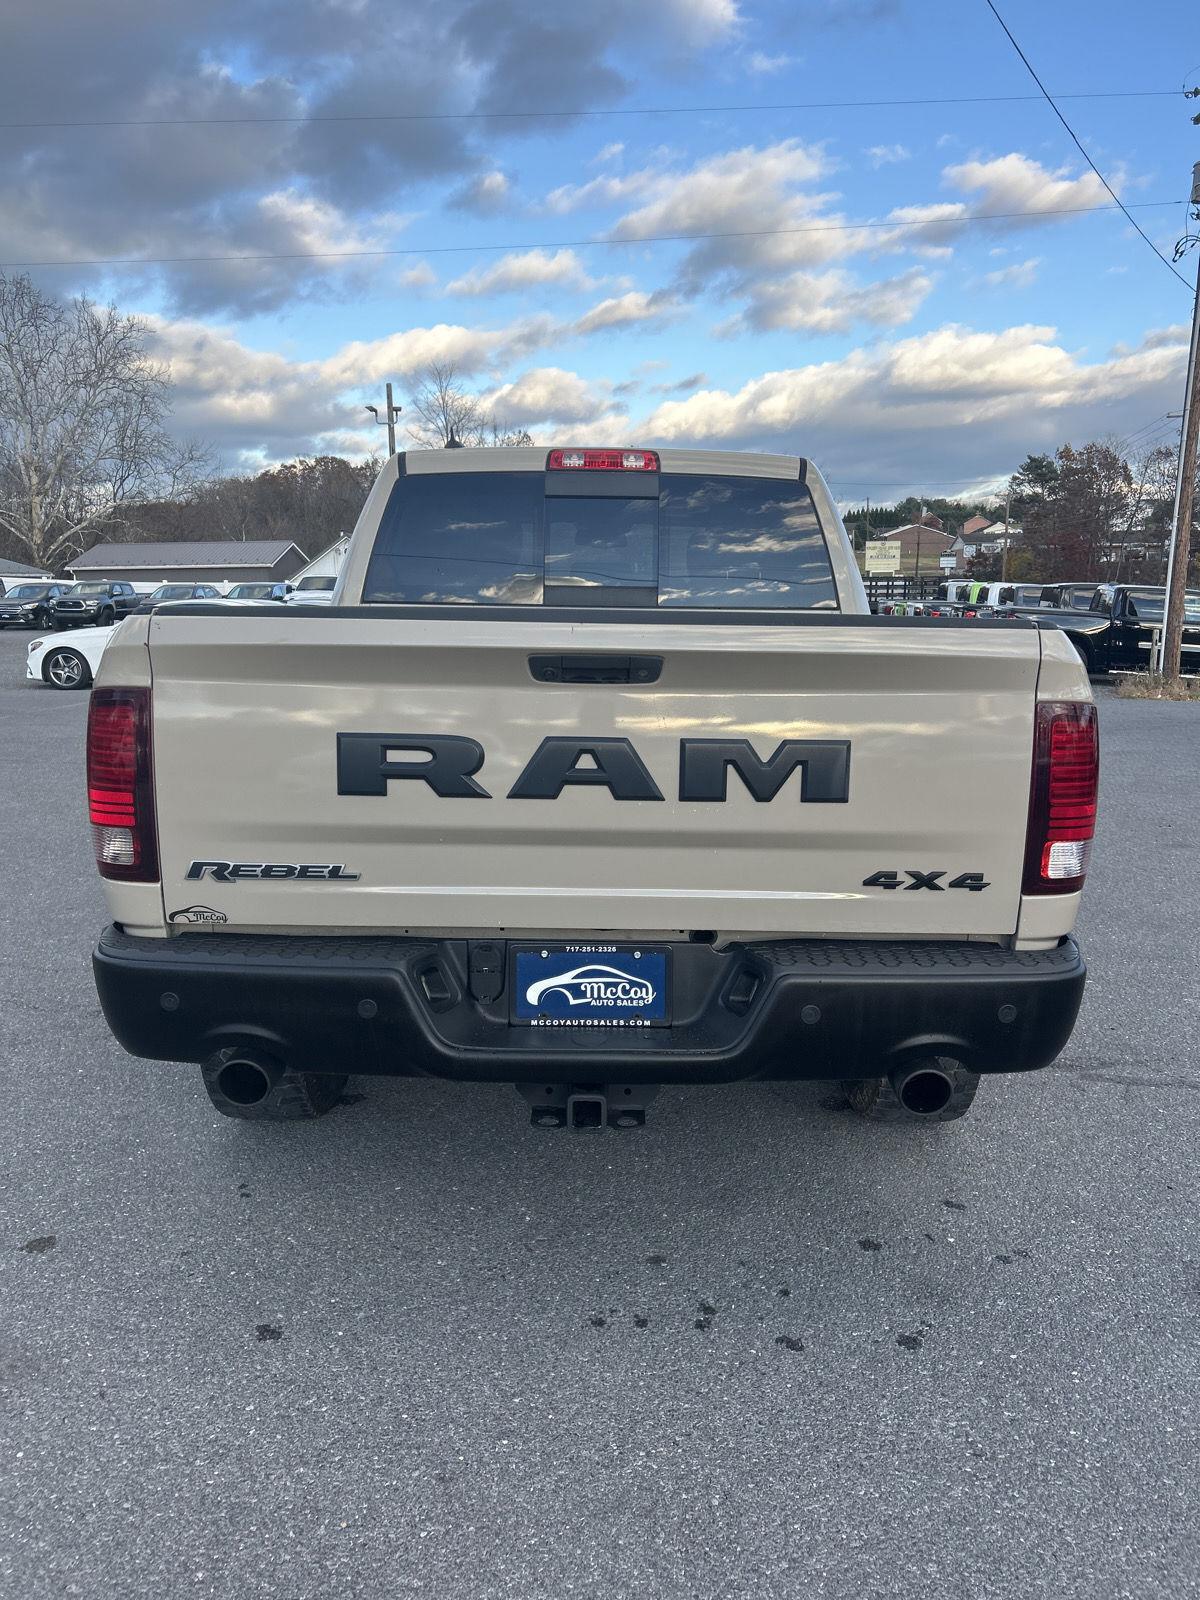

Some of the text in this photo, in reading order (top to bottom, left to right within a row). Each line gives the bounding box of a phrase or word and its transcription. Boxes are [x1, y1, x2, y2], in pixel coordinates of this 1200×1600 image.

[336, 732, 851, 803] RAM
[185, 860, 361, 883] REBEL
[581, 982, 656, 1005] McCoy
[590, 999, 645, 1007] AUTO SALES
[530, 1019, 651, 1027] MCCOYAUTOSALES.COM
